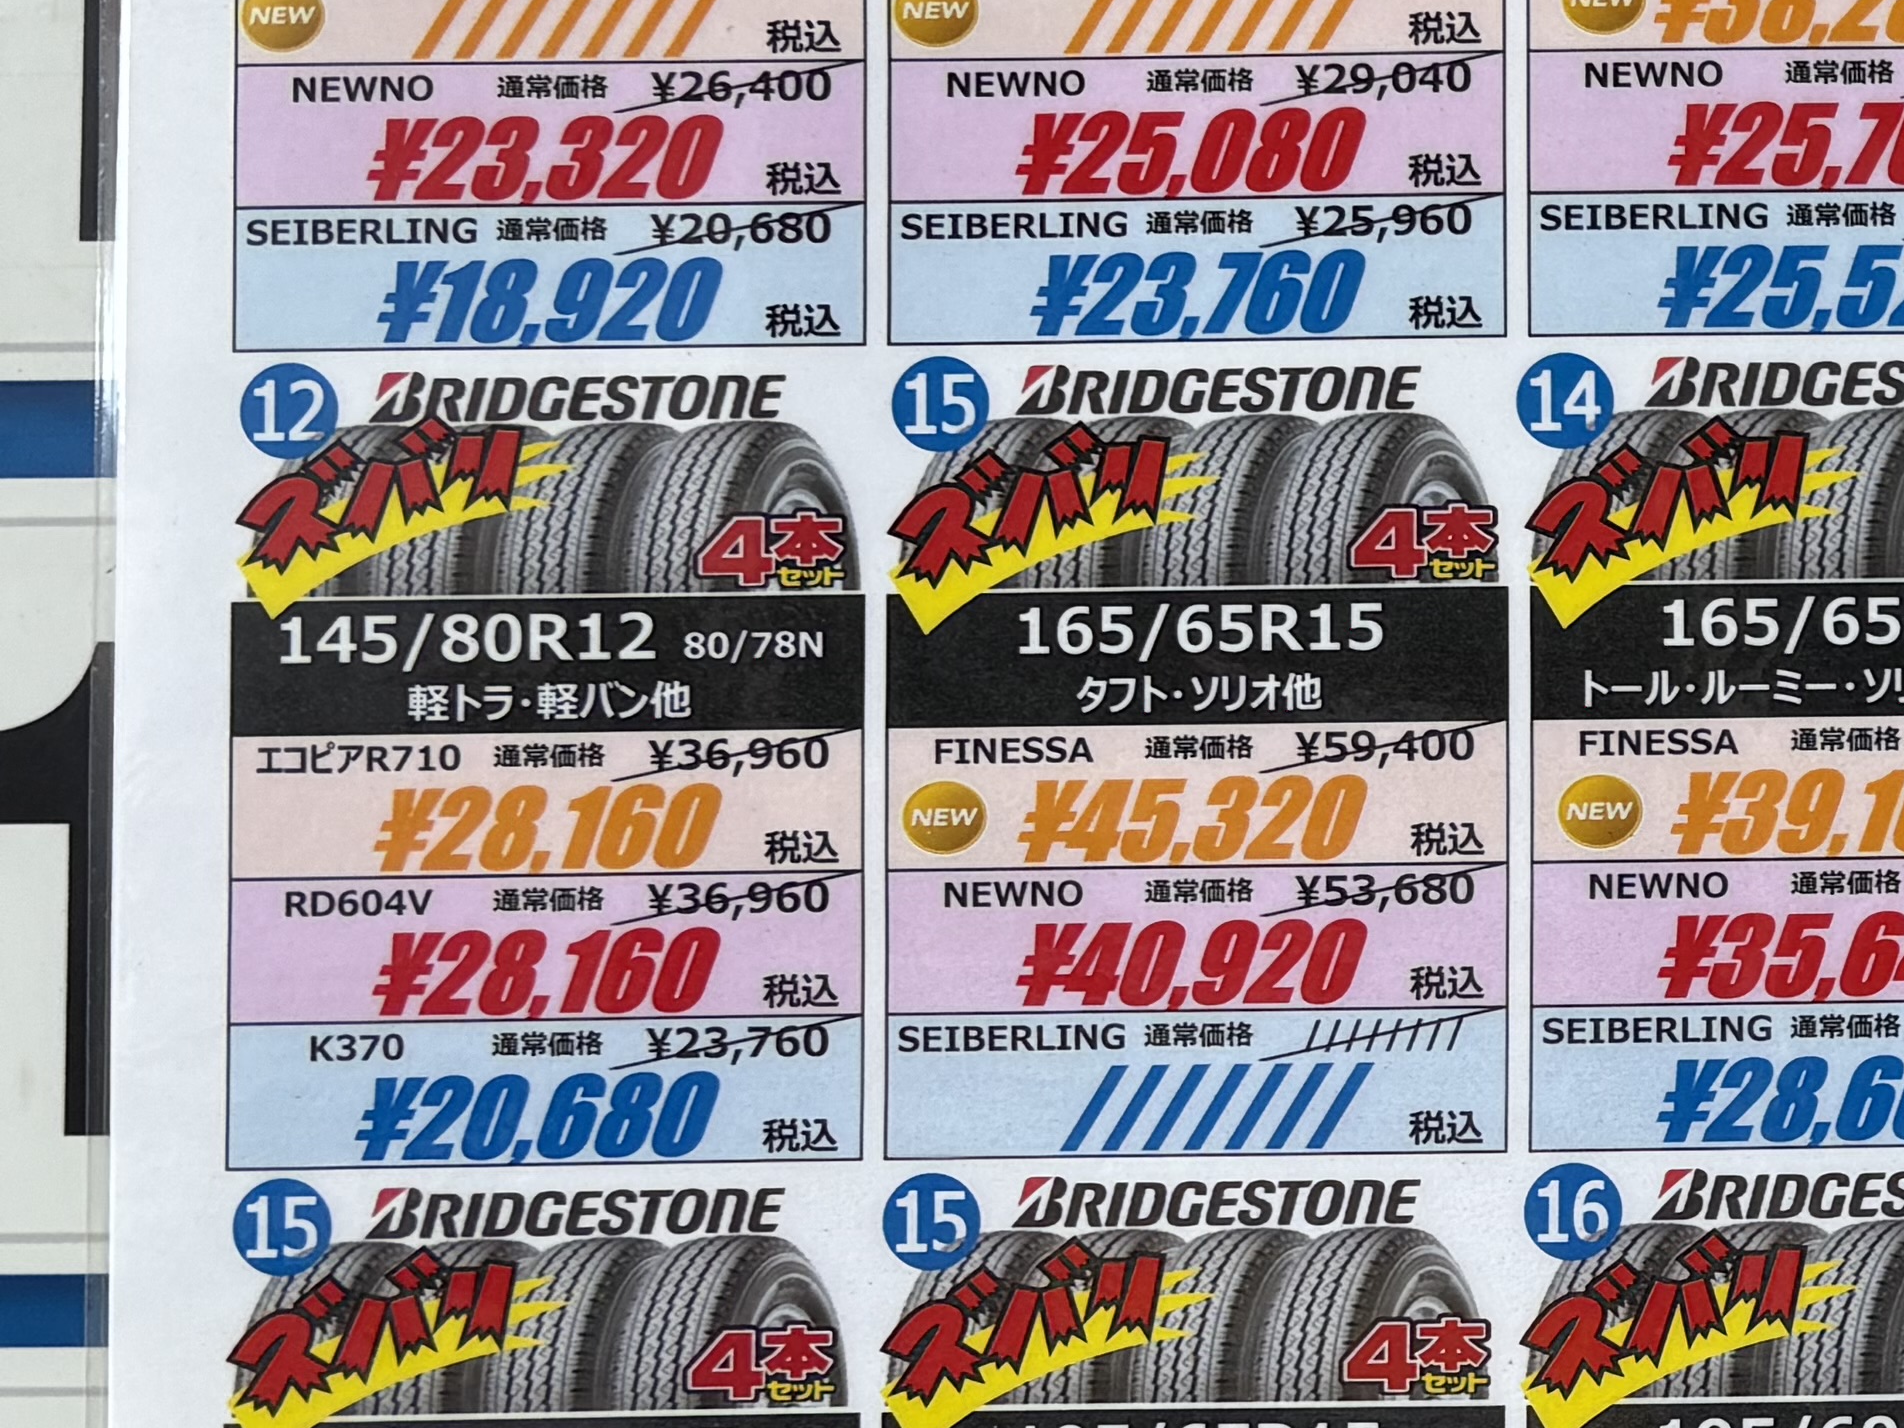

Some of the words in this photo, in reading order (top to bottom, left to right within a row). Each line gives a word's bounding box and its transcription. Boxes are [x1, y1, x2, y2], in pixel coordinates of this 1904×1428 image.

[249, 5, 314, 26] NEW
[293, 75, 433, 102] NEWNO
[497, 74, 608, 99] 通常価格
[651, 69, 832, 106] ¥26,400
[368, 115, 722, 206] ¥23,320
[766, 162, 841, 196] 税込
[1016, 108, 1365, 200] ¥25,080
[247, 218, 477, 246] SEIBERLING
[651, 210, 832, 249] ¥20,680
[378, 257, 722, 349] ¥18,920
[1031, 249, 1365, 341] ¥23,760
[368, 372, 785, 424] BRIDGESTONE
[281, 612, 655, 671] 145/80R12
[684, 630, 822, 663] 80/78N
[1020, 603, 1382, 661] 165/65R15
[256, 741, 460, 773] エコピアR710
[649, 735, 830, 773] ¥36,960
[376, 784, 721, 876] ¥28,160
[912, 807, 976, 827] NEW
[1019, 776, 1366, 864] ¥45,320
[285, 889, 432, 917] RD604V
[649, 880, 830, 919] ¥36,960
[373, 928, 721, 1021] ¥28,160
[311, 1034, 404, 1061] K370
[647, 1025, 829, 1063] ¥23,760
[1543, 1015, 1771, 1044] SEIBERLING
[356, 1071, 719, 1166] ¥20,680
[246, 1196, 317, 1258] 15
